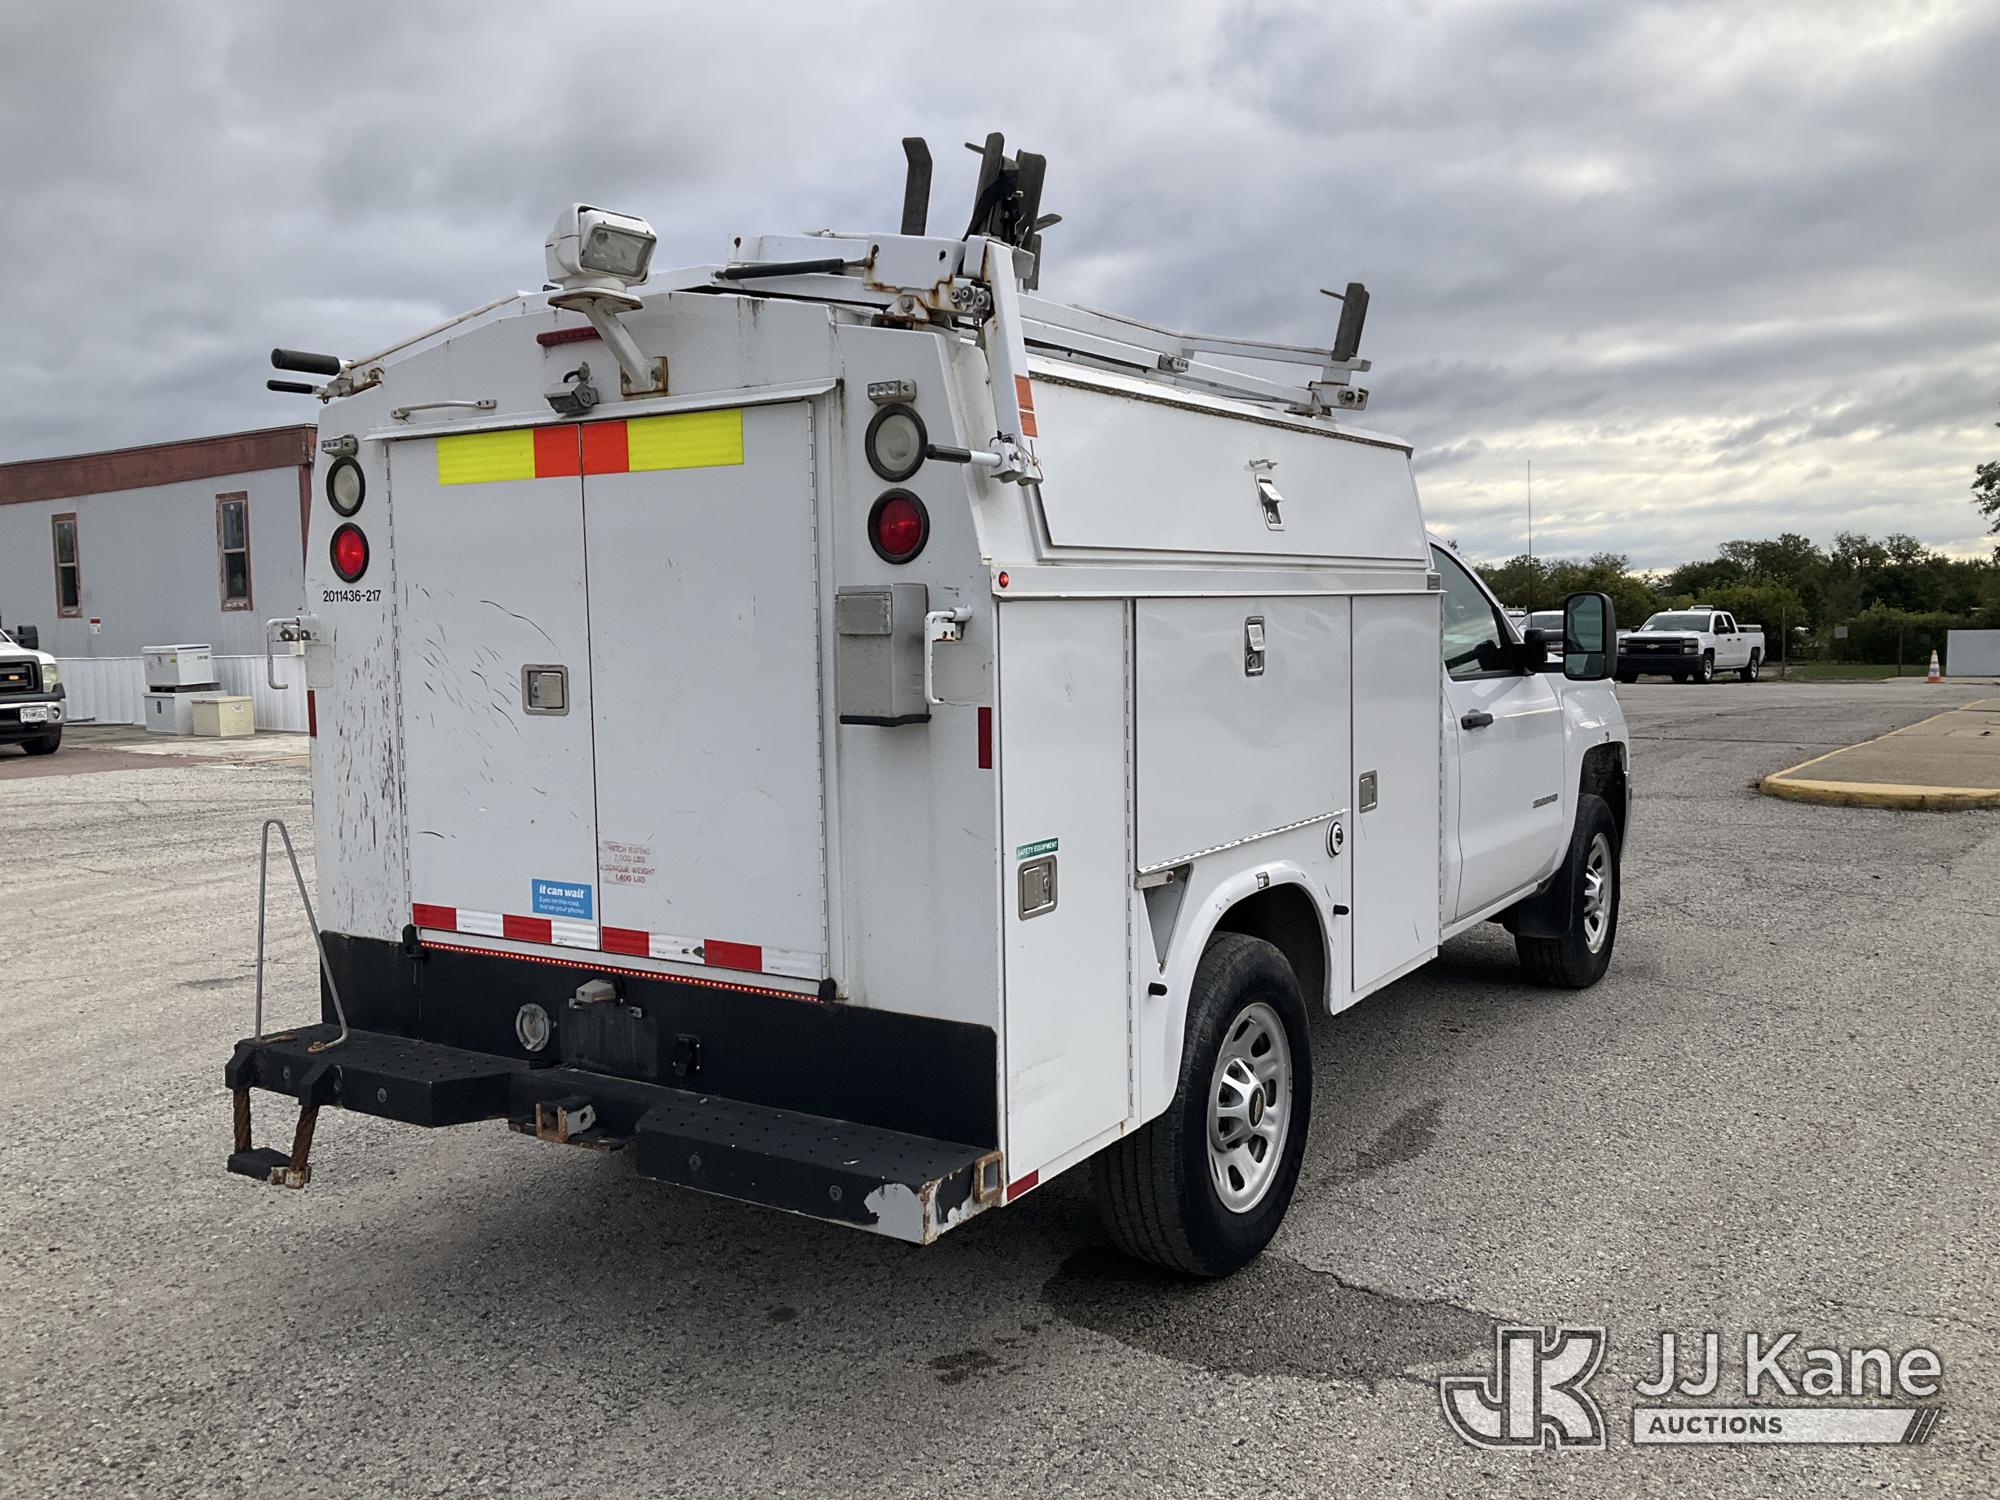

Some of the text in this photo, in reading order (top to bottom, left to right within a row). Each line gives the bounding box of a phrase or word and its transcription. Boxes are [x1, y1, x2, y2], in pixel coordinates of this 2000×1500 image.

[323, 590, 381, 602] 2011436-217
[1018, 841, 1057, 857] SAFETY EQUIPMENT
[539, 884, 584, 899] it can wait
